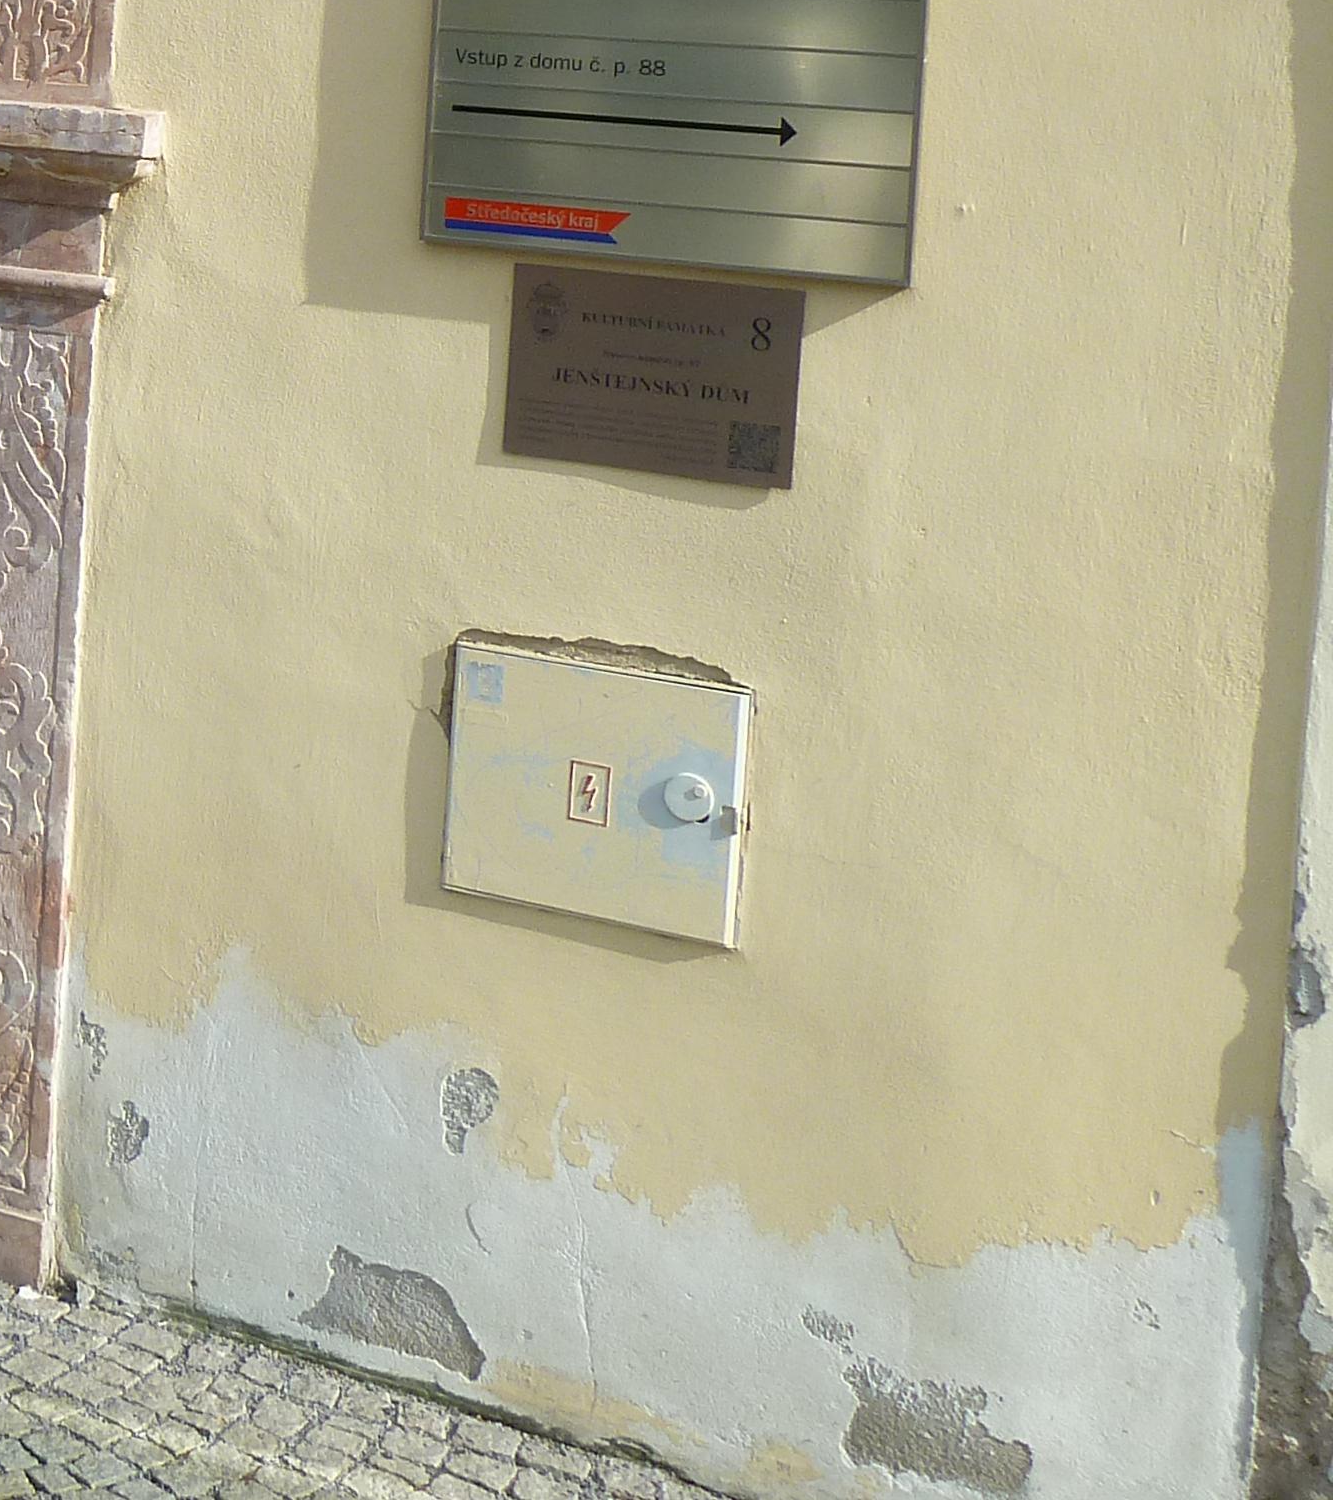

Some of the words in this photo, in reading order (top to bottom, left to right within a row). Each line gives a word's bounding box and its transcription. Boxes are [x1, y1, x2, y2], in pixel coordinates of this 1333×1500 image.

[455, 48, 508, 69] Vstup
[514, 55, 524, 68] z
[530, 53, 582, 71] domu
[589, 56, 606, 73] č.
[613, 60, 631, 77] p.
[639, 59, 666, 77] 88
[466, 203, 564, 228] Středočeský
[568, 211, 599, 231] kraj
[750, 317, 772, 351] 8
[552, 367, 693, 398] JENŠTEJNSKÝ
